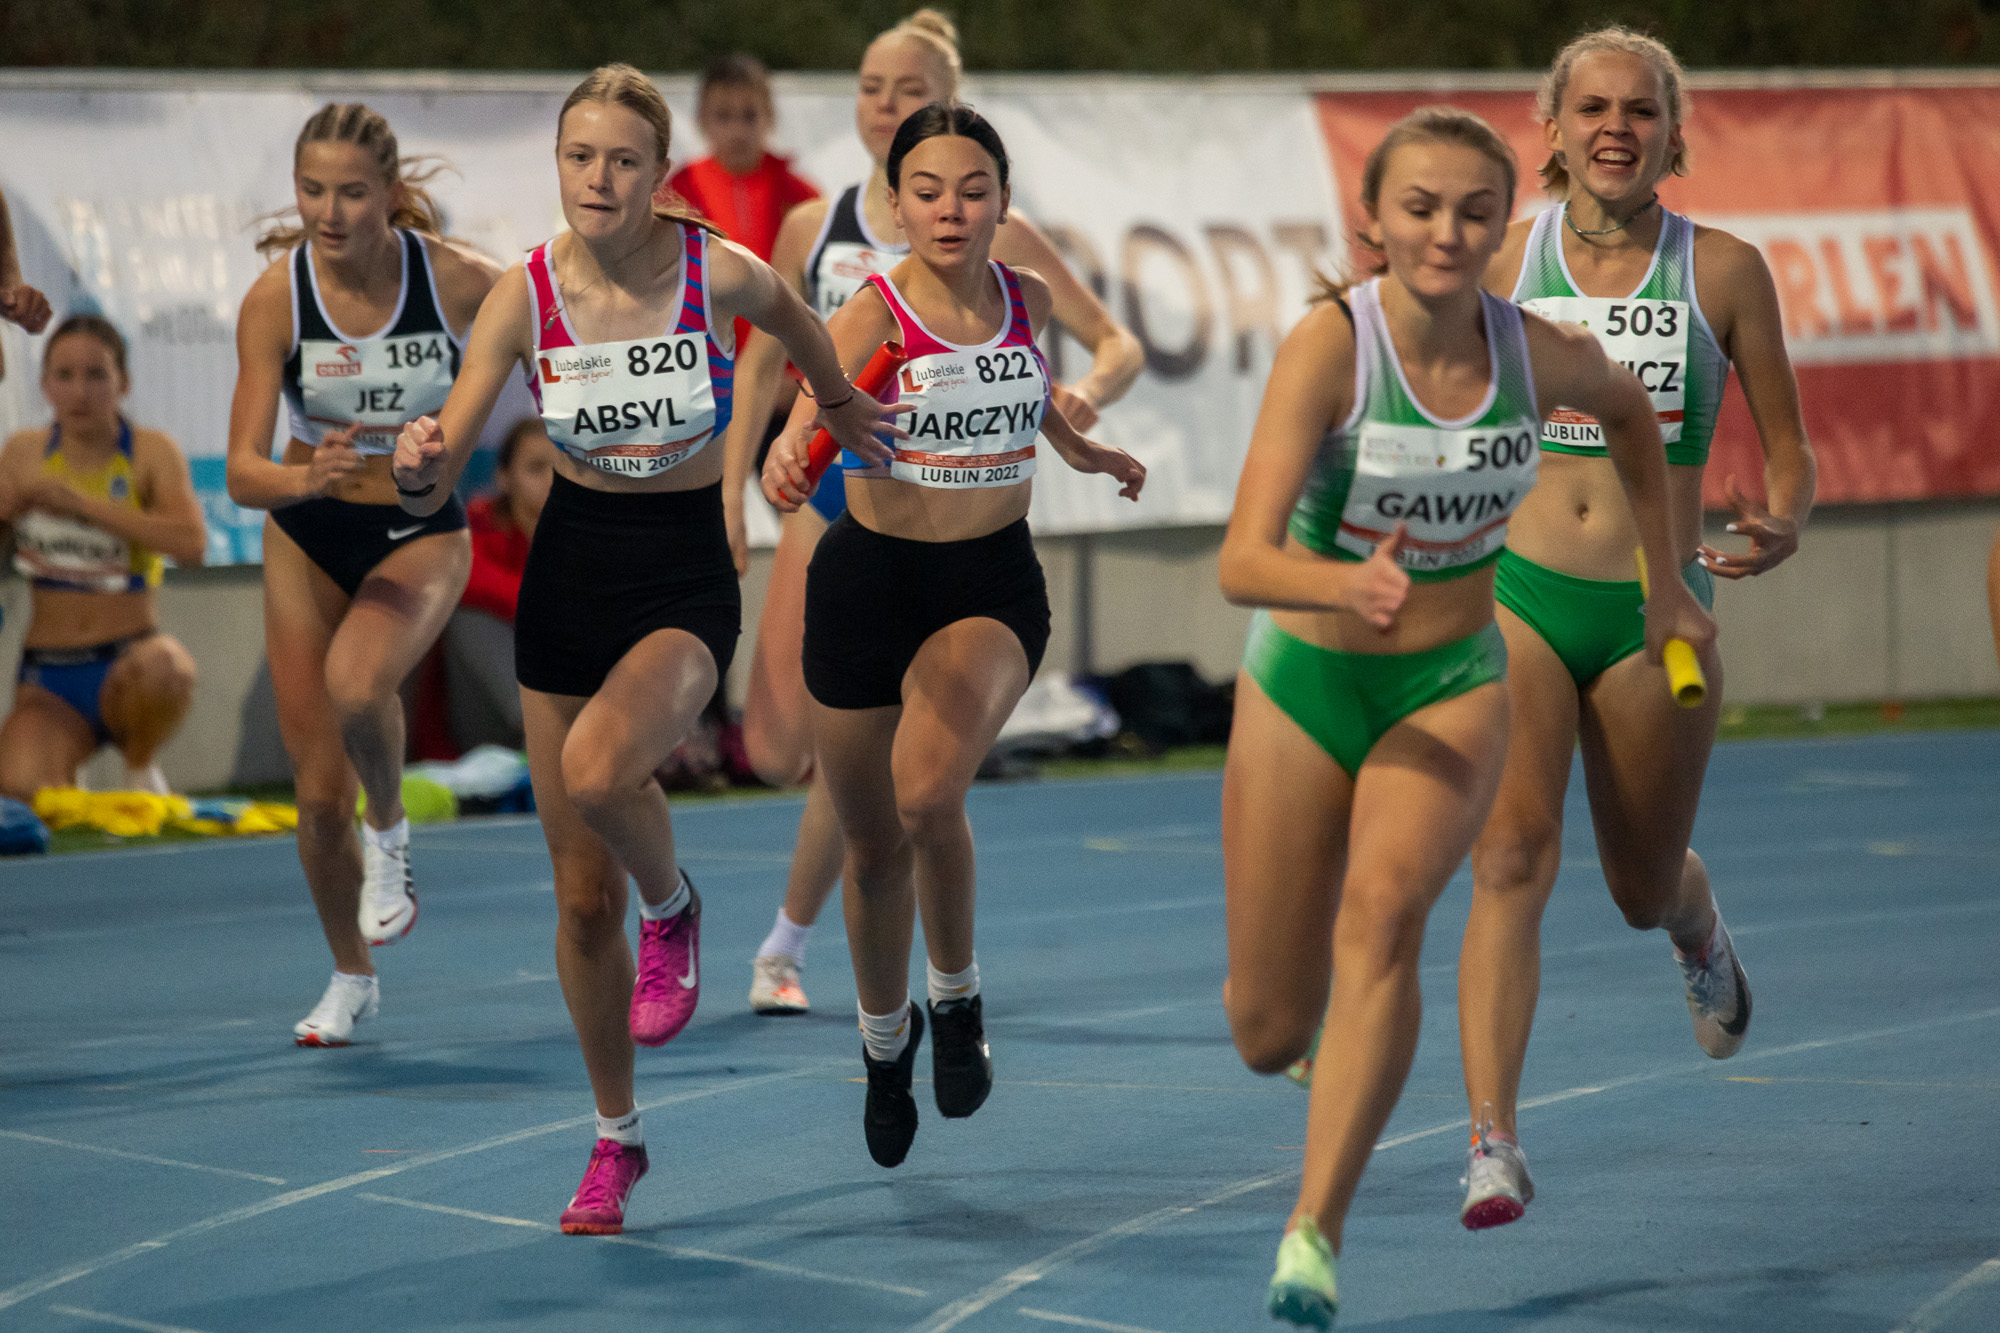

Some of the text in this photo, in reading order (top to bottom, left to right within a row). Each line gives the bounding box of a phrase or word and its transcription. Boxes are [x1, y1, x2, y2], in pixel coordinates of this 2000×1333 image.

[1606, 305, 1678, 337] 503
[385, 338, 443, 369] 184
[555, 355, 611, 373] lubelskie
[627, 339, 698, 377] 820
[975, 351, 1034, 384] 822
[916, 364, 965, 382] lubelskie
[573, 398, 686, 435] ABSYL
[908, 400, 1040, 440] JARCZYK
[589, 457, 641, 472] UBLIN
[1467, 432, 1532, 472] 500
[921, 465, 1019, 483] LUBLIN 2022
[1376, 489, 1515, 525] GAWIN
